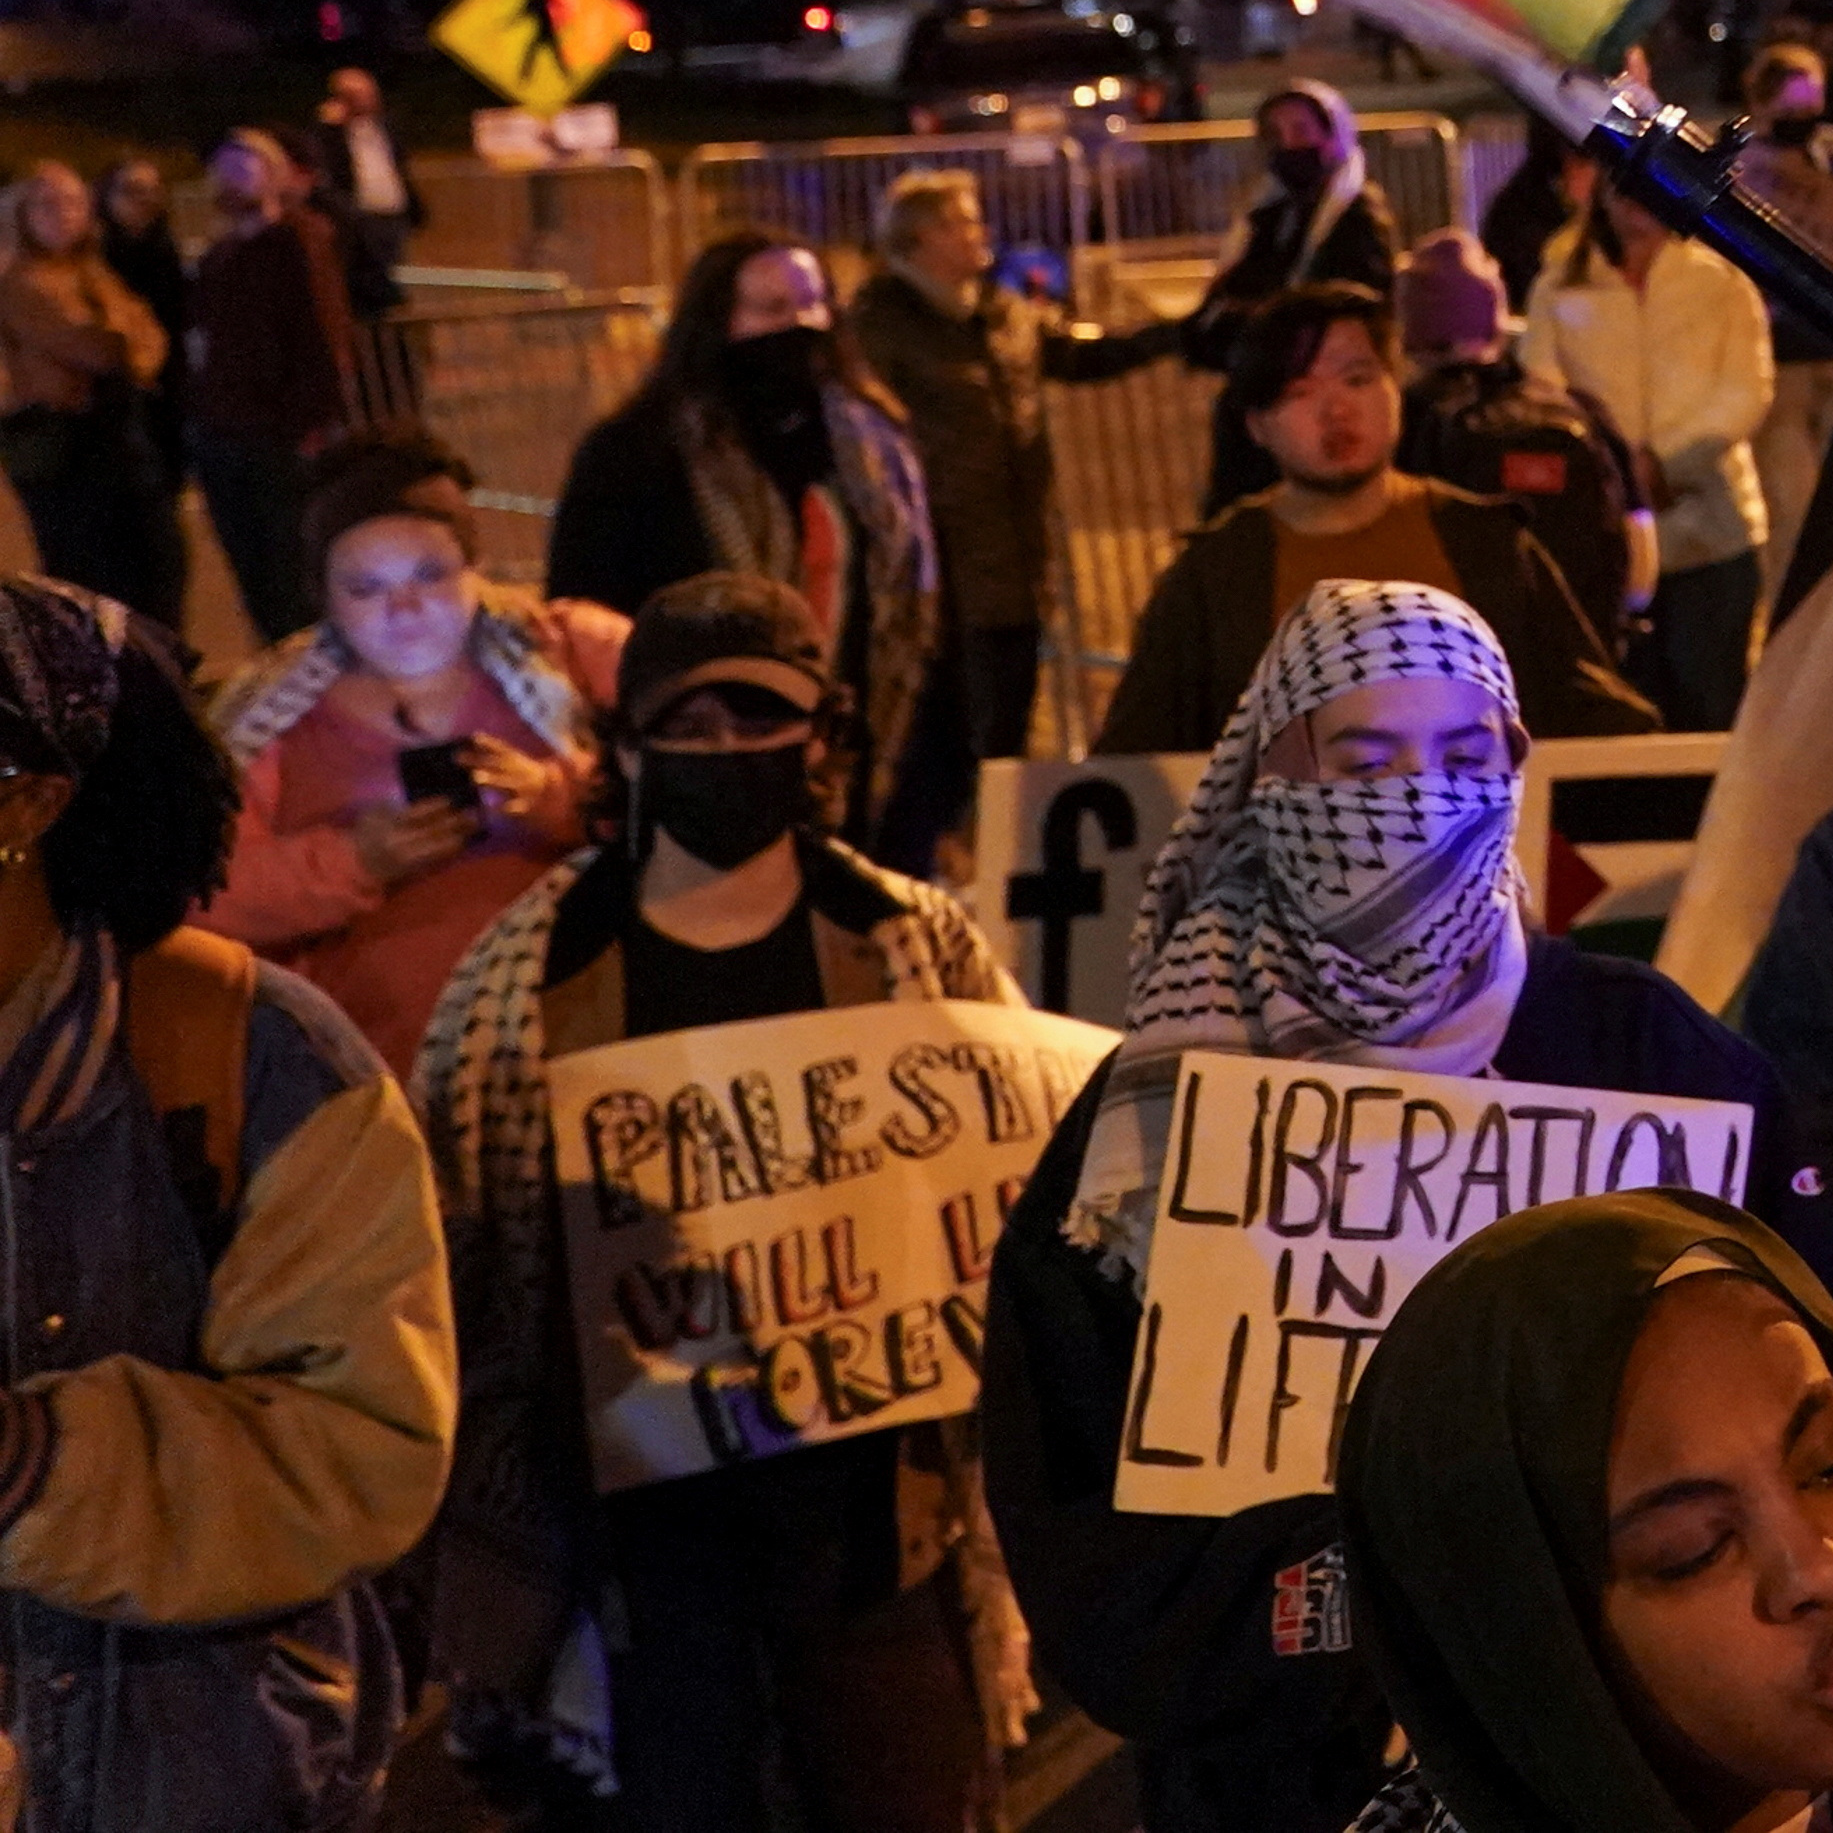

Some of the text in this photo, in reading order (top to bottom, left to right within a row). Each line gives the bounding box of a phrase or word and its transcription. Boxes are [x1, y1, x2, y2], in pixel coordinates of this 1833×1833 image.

[582, 1042, 1082, 1231] PALESTI
[1168, 1070, 1741, 1242] LIBERATION
[615, 1215, 879, 1349] WILL
[1274, 1247, 1387, 1320] IN
